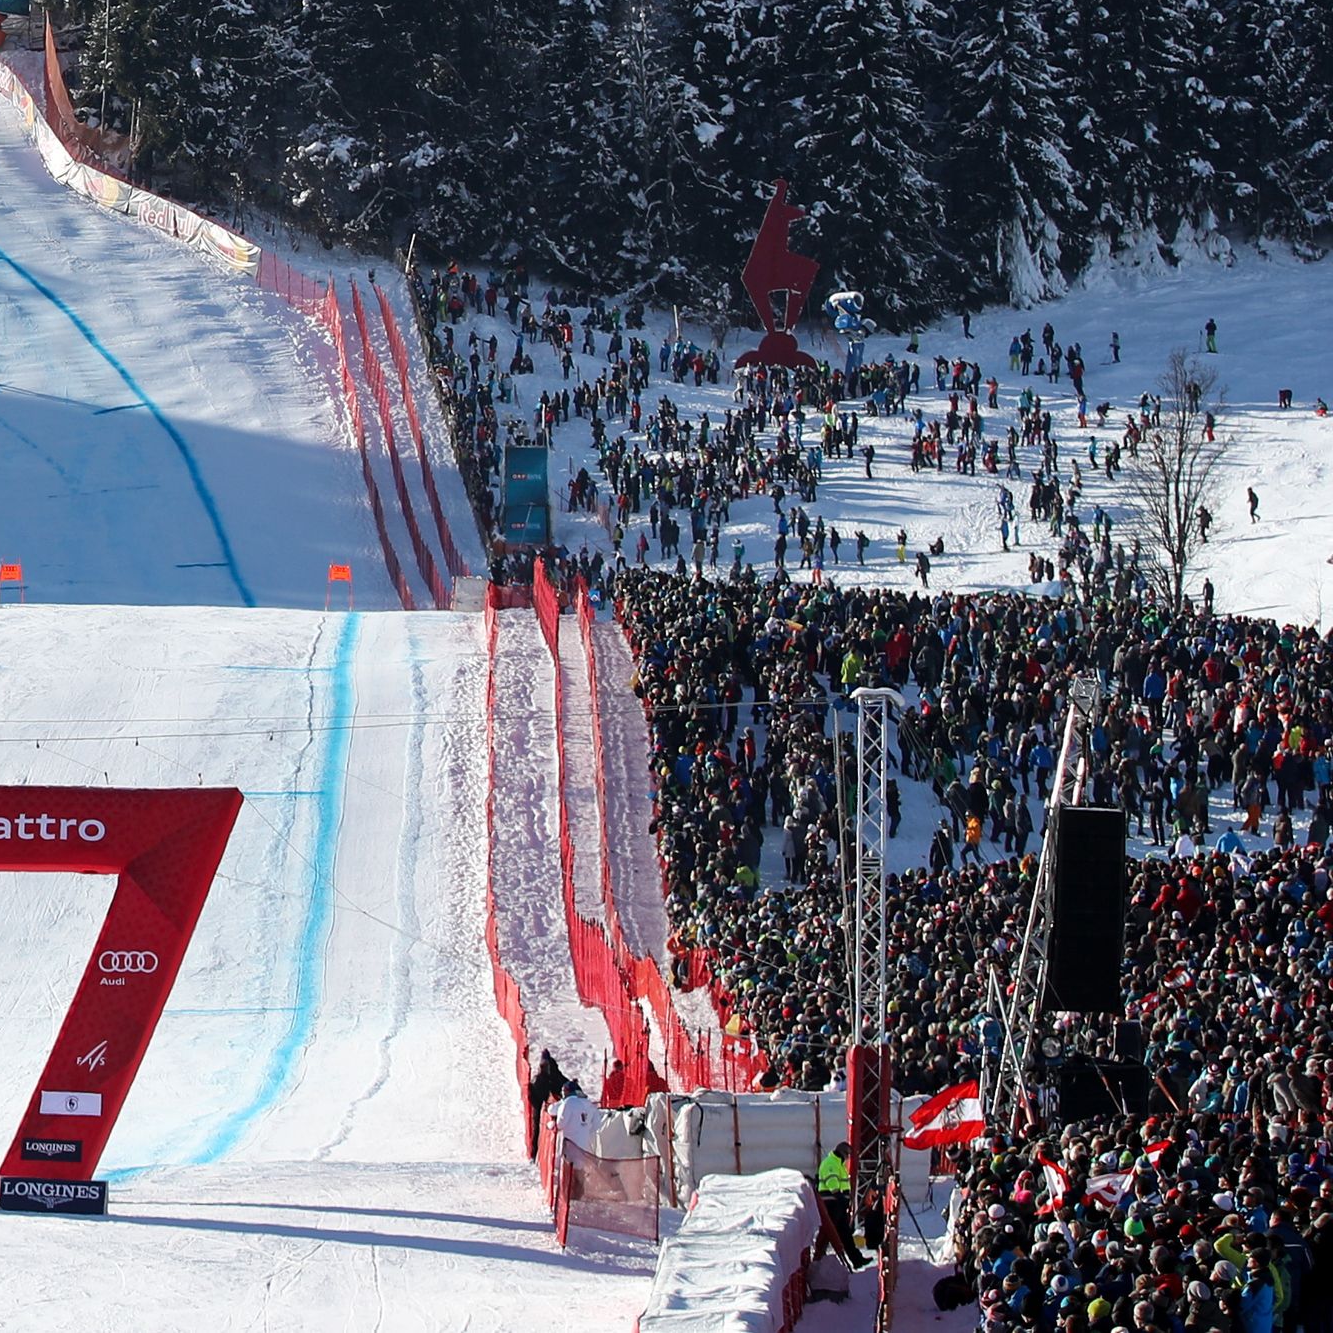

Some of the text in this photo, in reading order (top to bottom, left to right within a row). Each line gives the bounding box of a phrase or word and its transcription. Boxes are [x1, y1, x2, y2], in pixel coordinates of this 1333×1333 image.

[138, 201, 169, 230] Red
[100, 977, 125, 986] Audi
[25, 1141, 76, 1153] LONGINES
[3, 1181, 100, 1200] LONGINES
